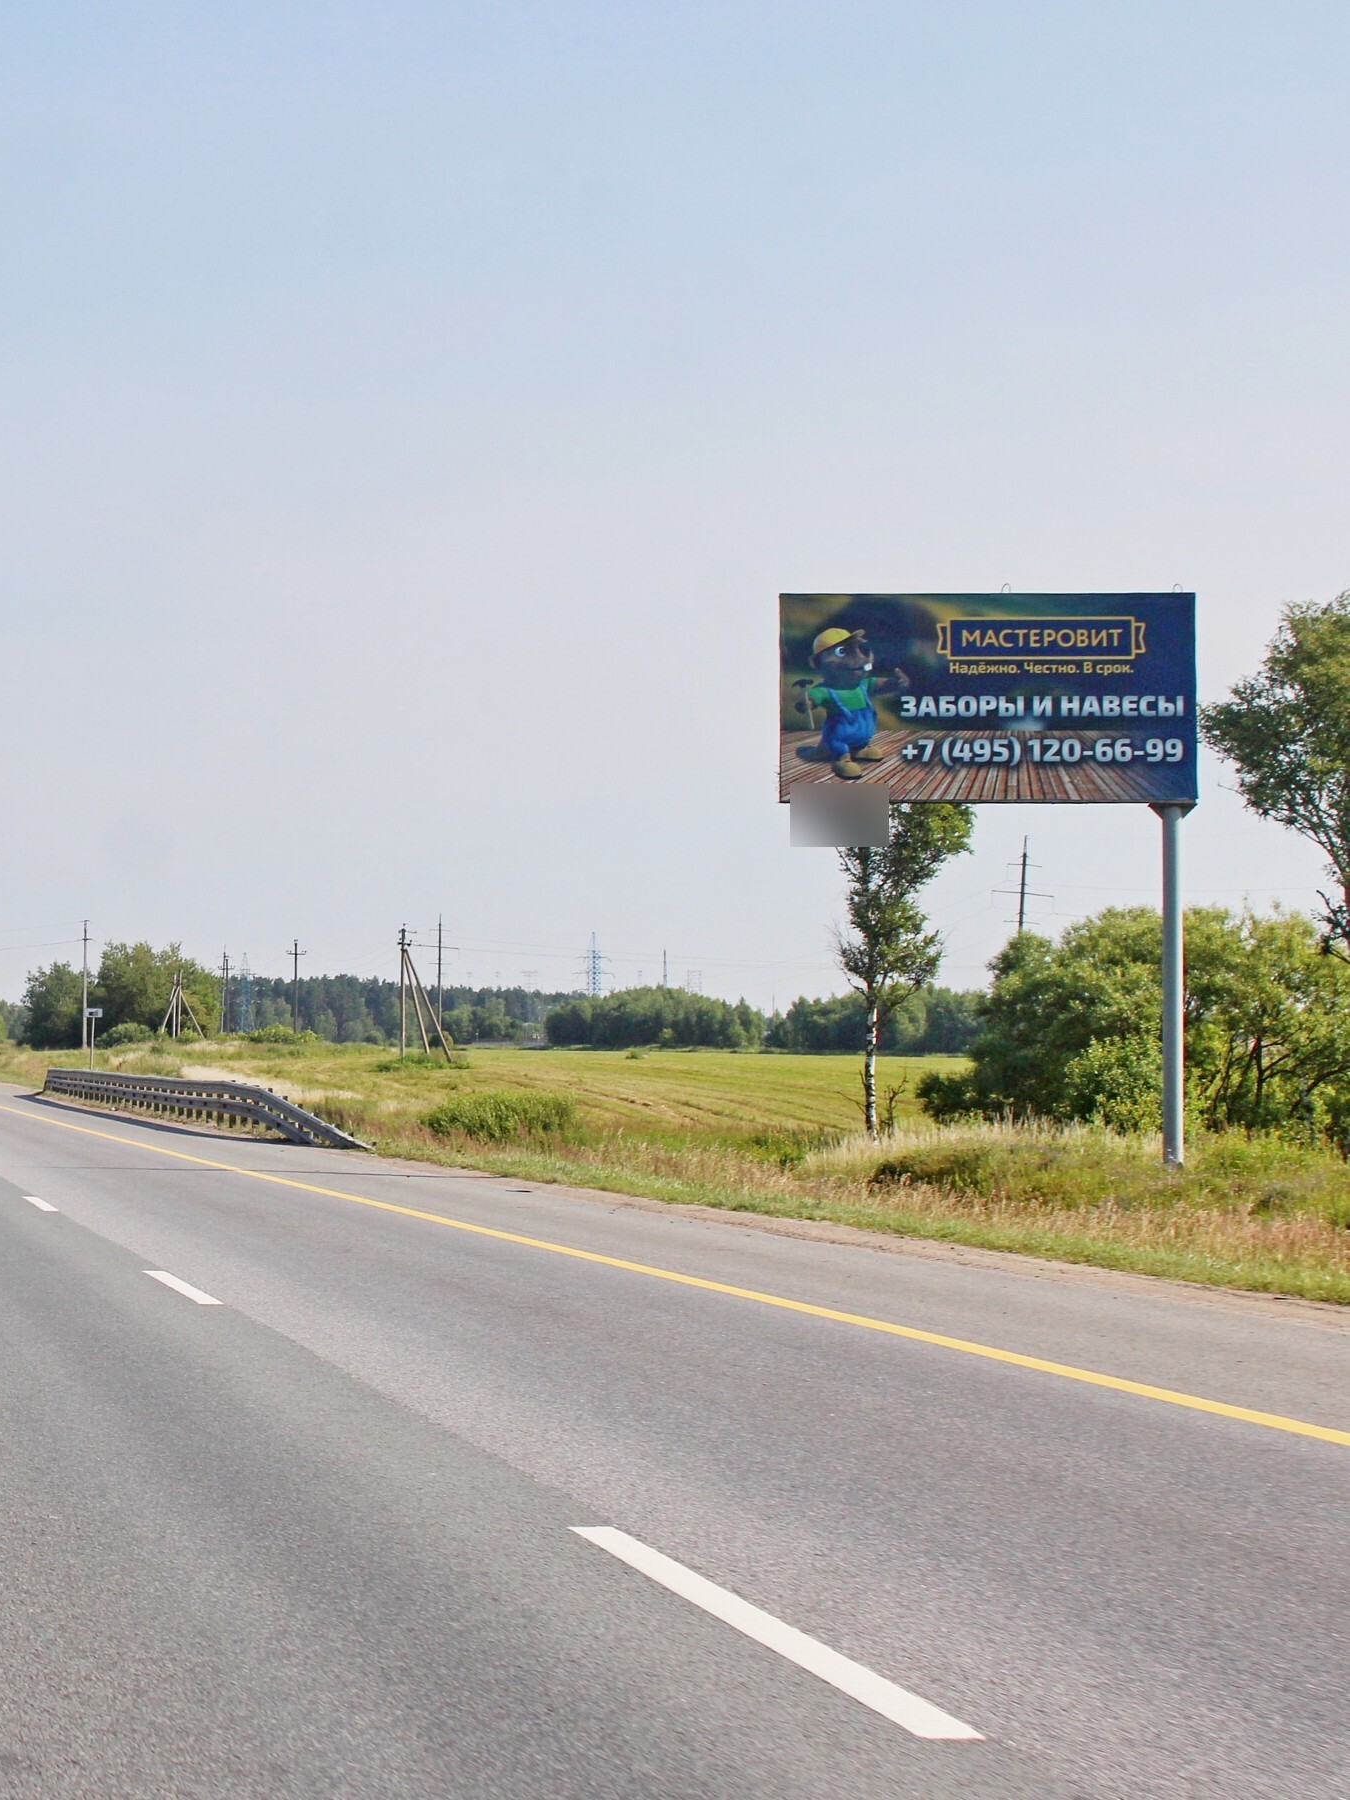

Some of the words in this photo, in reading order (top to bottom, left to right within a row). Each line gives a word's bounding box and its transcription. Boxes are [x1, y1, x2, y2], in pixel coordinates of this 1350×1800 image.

[961, 629, 1124, 647] МАСТЕРОВИТ
[949, 661, 1021, 675] Надёжно.
[1024, 661, 1080, 674] Честно.
[1083, 661, 1093, 674] В
[1096, 664, 1134, 676] срок.
[900, 695, 1025, 717] ЗАБОРЫ
[1032, 695, 1053, 717] И
[1060, 695, 1184, 717] НАВЕСЫ
[901, 738, 935, 762] +7
[942, 737, 1021, 766] (495)
[1027, 738, 1184, 763] 120-66-99
